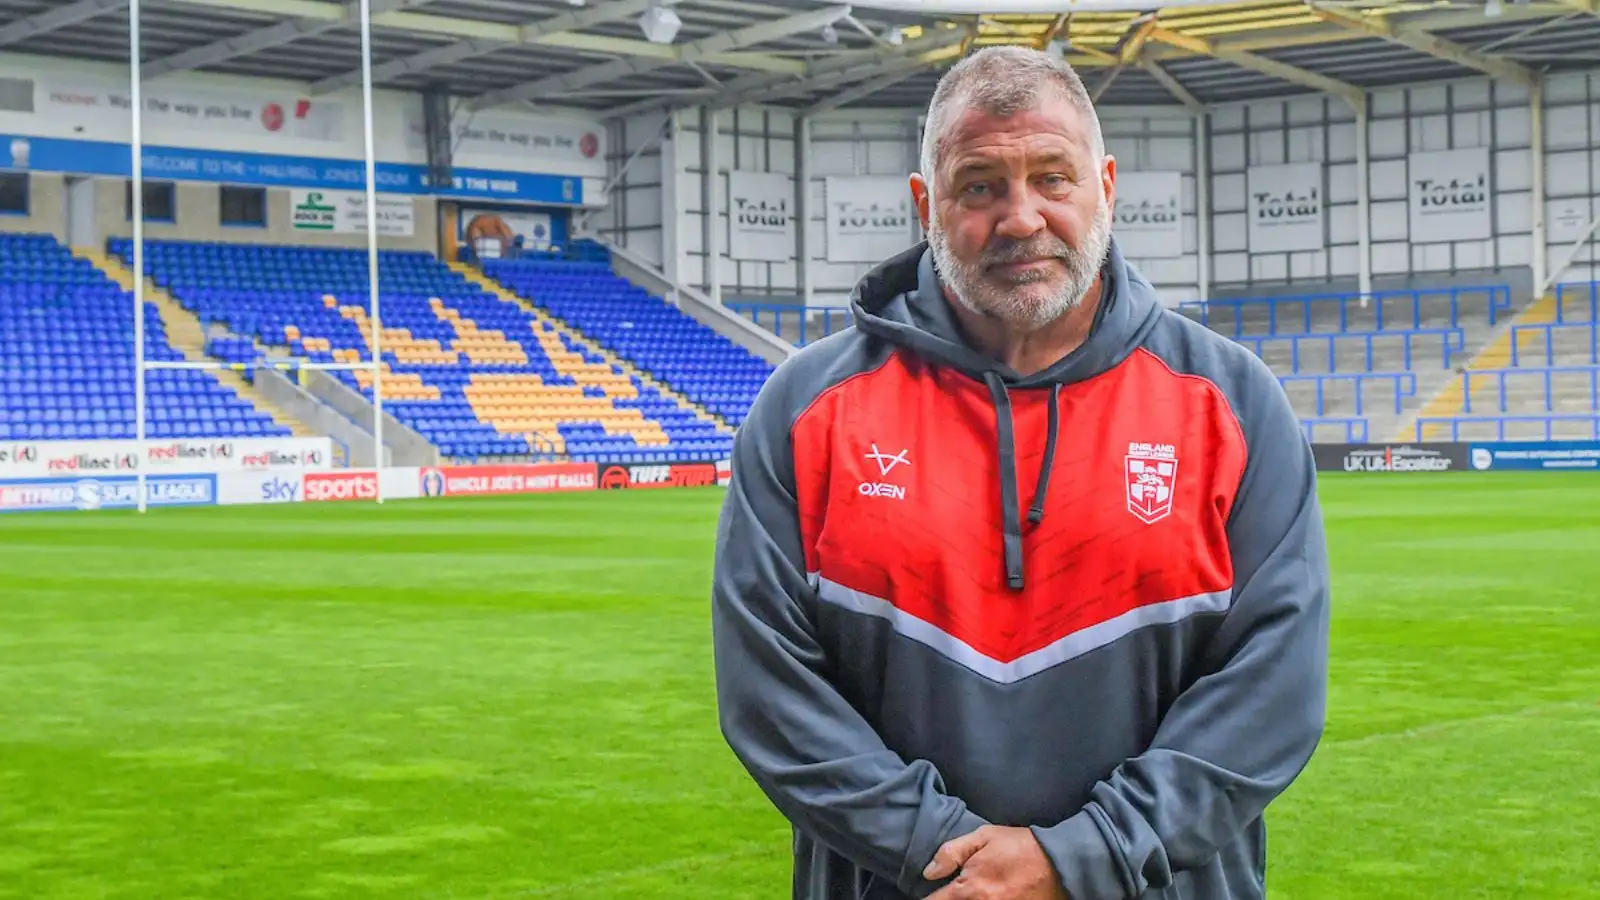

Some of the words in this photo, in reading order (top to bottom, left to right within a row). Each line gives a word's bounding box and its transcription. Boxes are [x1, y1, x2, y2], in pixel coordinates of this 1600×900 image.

[1253, 187, 1317, 218] Total
[1415, 174, 1485, 206] Total
[736, 198, 786, 226] Total
[834, 201, 907, 227] Total
[1129, 442, 1175, 452] ENGLAND
[261, 477, 297, 502] sky
[305, 477, 376, 500] sports
[556, 472, 593, 488] BALLS
[858, 482, 906, 500] OXEN
